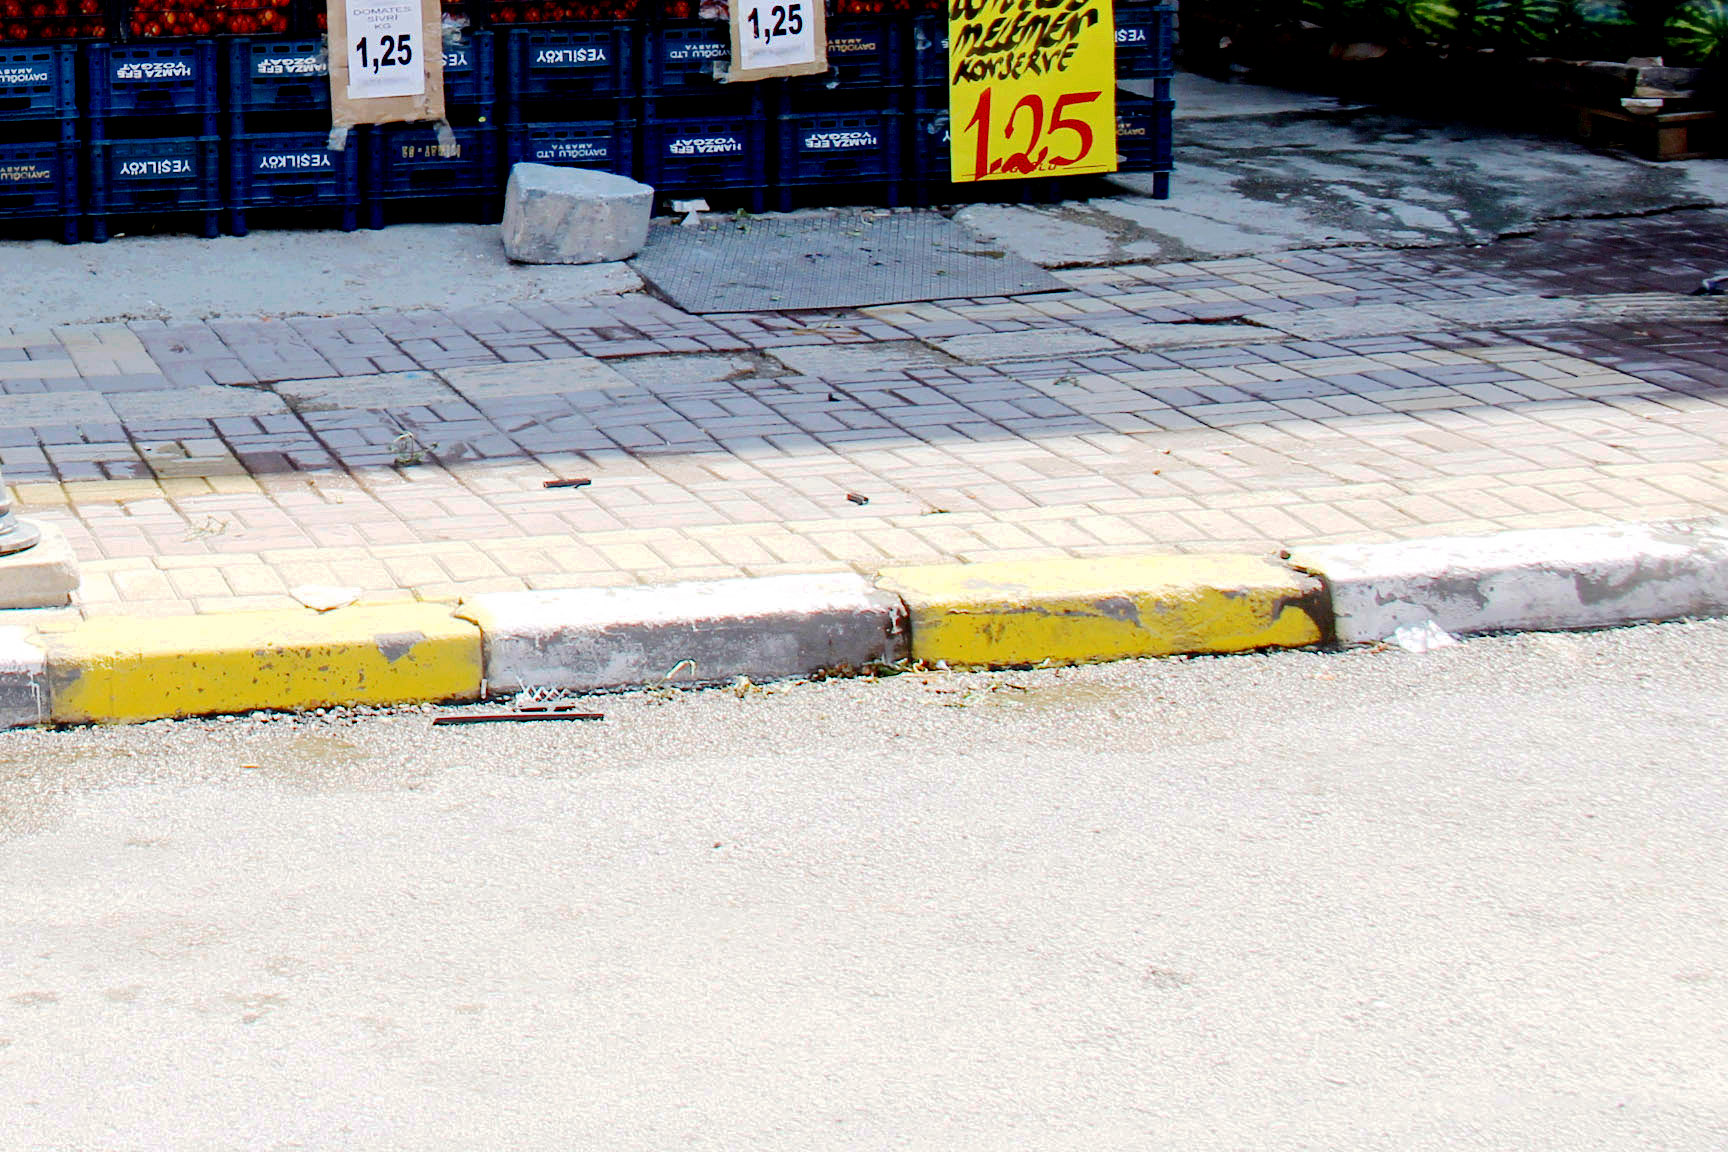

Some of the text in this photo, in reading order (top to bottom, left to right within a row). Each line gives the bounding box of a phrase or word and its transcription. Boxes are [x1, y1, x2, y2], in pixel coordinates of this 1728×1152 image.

[353, 6, 412, 16] DOMATES
[747, 3, 803, 45] 1,25
[356, 34, 412, 74] 1,25
[536, 48, 607, 63] YEŞİLKÖY
[952, 43, 1079, 85] KONSERVE
[145, 66, 192, 78] HAMZA
[697, 143, 742, 153] HAMZA
[832, 136, 878, 147] HAMZA
[120, 159, 192, 175] YEŞİLKÖY
[259, 153, 331, 169] YEŞİLKÖY
